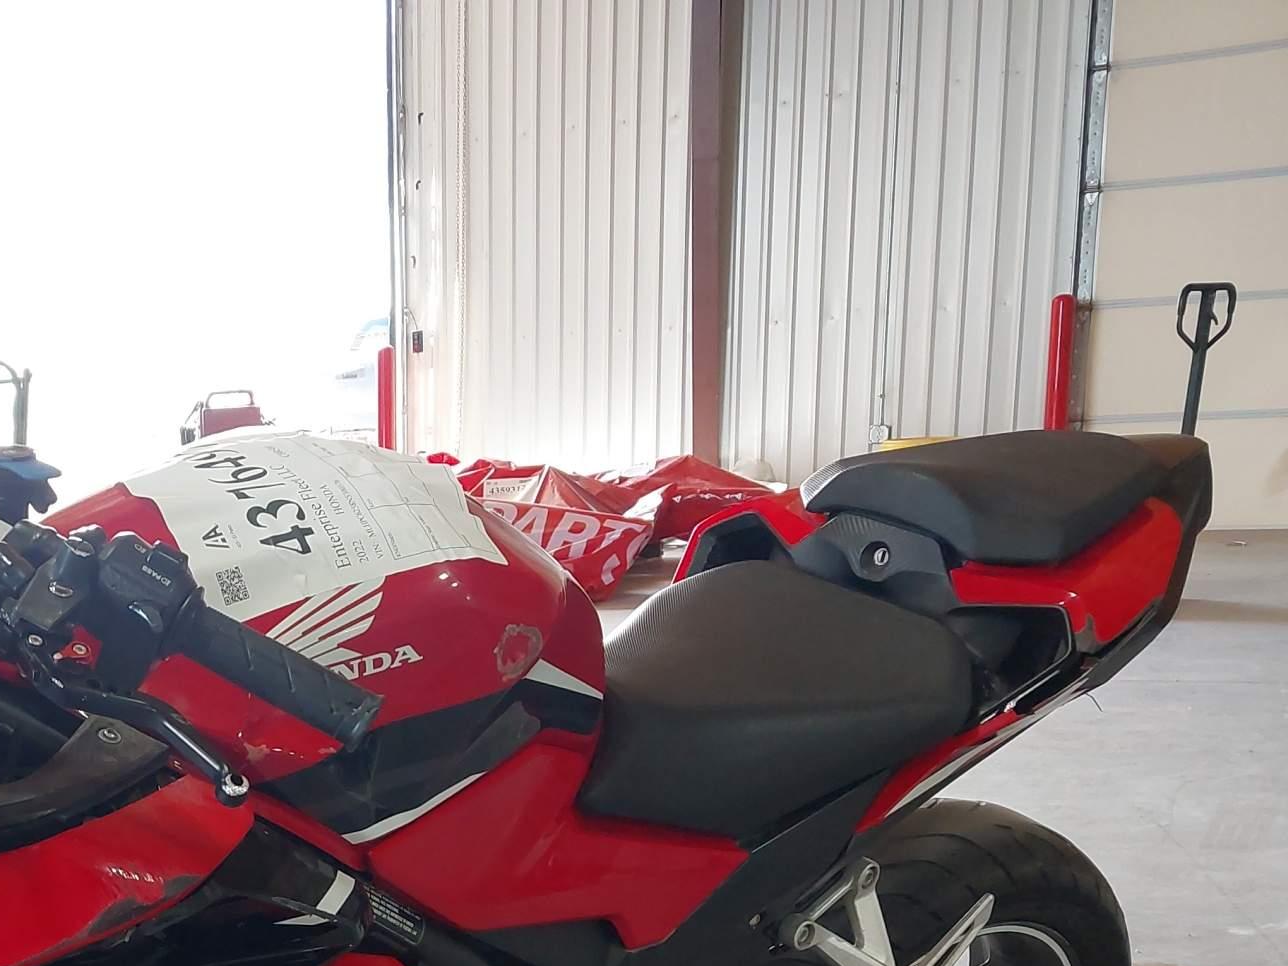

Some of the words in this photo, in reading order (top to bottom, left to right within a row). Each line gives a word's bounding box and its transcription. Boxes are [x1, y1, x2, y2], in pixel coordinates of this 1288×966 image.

[320, 484, 345, 515] HONDA
[311, 502, 352, 569] Enterprise
[329, 644, 424, 681] NDA
